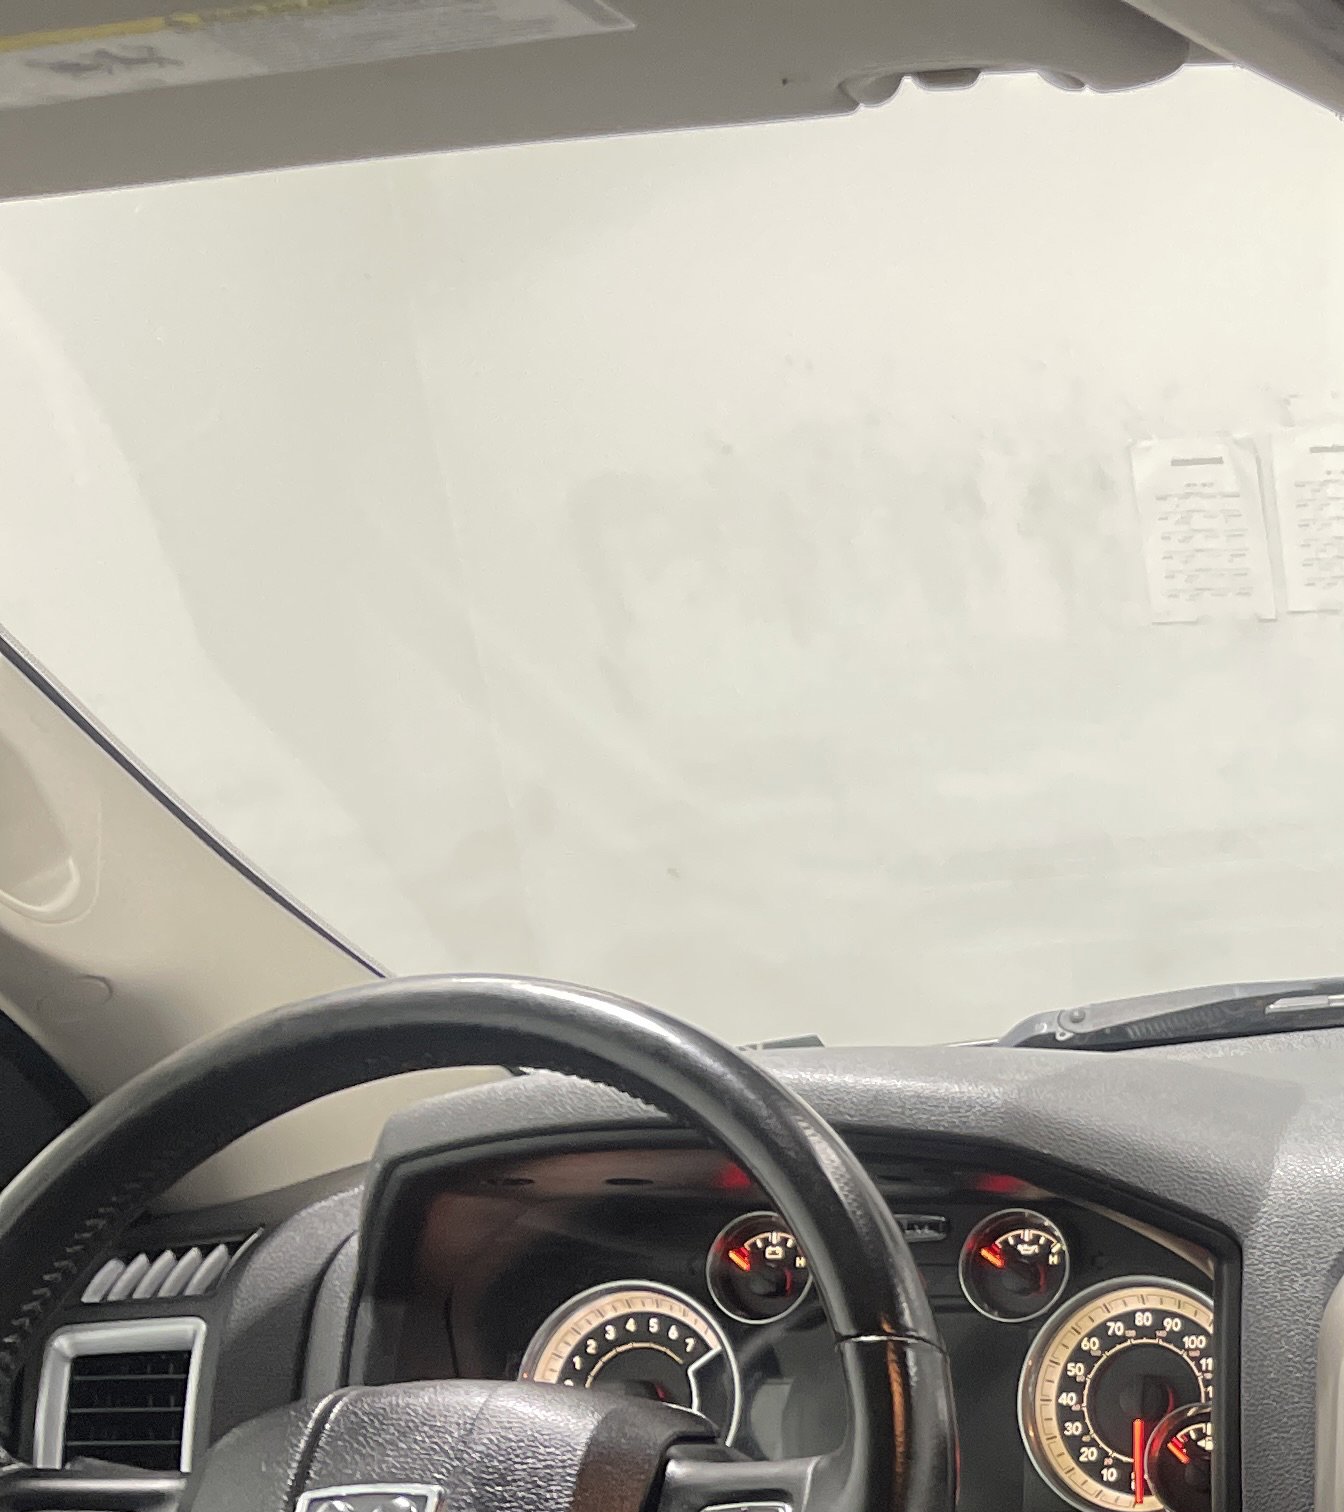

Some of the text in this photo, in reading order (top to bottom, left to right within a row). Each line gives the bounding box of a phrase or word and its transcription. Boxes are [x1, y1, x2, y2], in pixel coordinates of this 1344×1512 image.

[625, 1316, 637, 1333] 4
[648, 1317, 660, 1334] 5
[1134, 1311, 1153, 1327] 80
[1163, 1318, 1182, 1333] 90
[604, 1324, 617, 1341] 3
[668, 1324, 680, 1341] 6
[1106, 1321, 1125, 1337] 70
[586, 1338, 598, 1356] 2
[684, 1337, 696, 1353] 7
[1080, 1337, 1100, 1351] 60
[1182, 1335, 1207, 1349] 100
[573, 1355, 584, 1371] 1
[1066, 1362, 1085, 1377] 50
[1058, 1392, 1077, 1406] 40
[1063, 1422, 1083, 1436] 30
[1078, 1447, 1098, 1462] 20
[1100, 1468, 1118, 1482] 10
